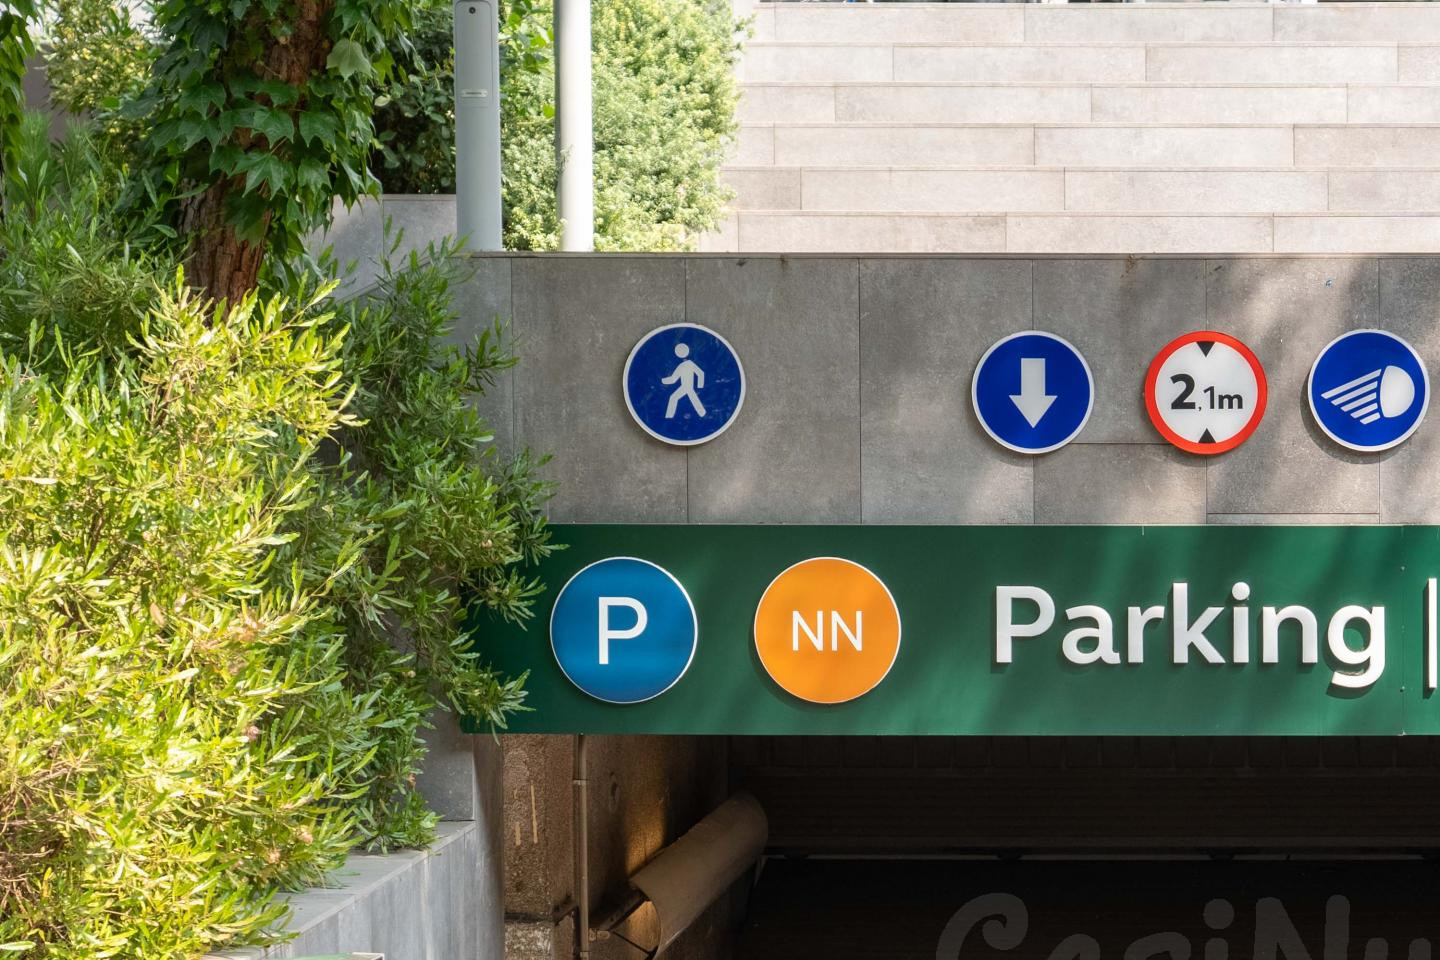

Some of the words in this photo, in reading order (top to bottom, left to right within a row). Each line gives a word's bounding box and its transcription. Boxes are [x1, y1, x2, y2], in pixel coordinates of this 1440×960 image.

[598, 596, 648, 665] P
[792, 610, 863, 651] NN
[996, 582, 1386, 689] Parking
